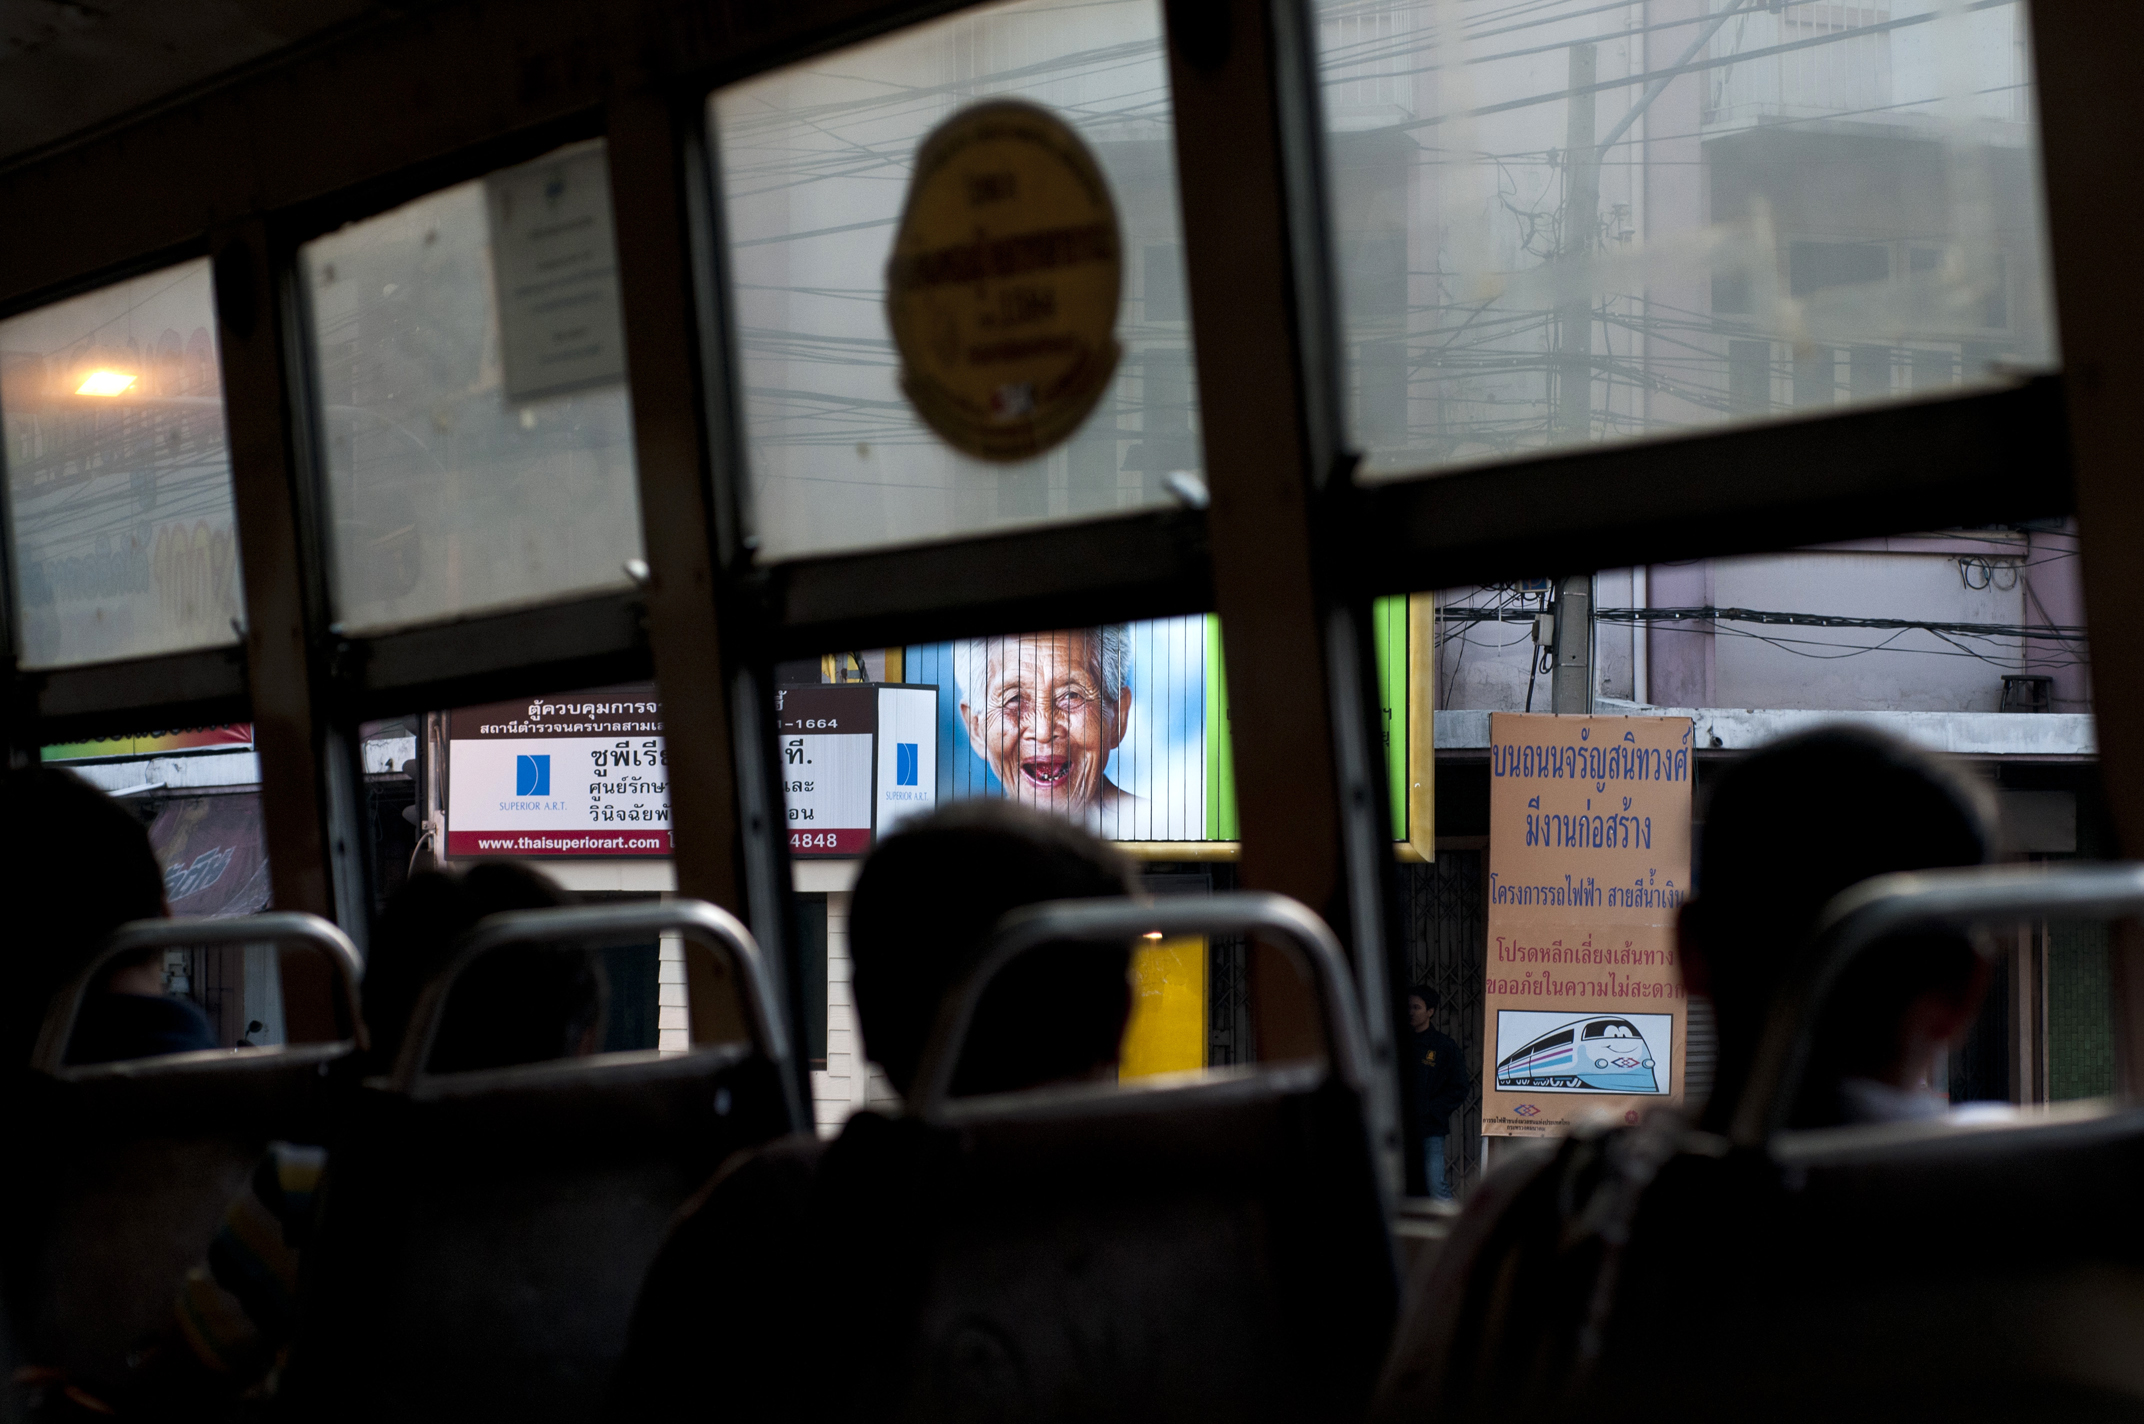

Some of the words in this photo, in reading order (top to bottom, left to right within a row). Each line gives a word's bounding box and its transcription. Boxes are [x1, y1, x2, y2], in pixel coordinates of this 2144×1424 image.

[1492, 727, 1692, 793] บนถนนจรัญสนิทวงศ์
[499, 801, 540, 811] SUPERIOR
[544, 801, 568, 811] A.R.T.
[886, 790, 912, 800] SUPERIOR
[1526, 795, 1651, 849] มีงานก่อสร้าง
[478, 836, 660, 851] www.thaisuperiorart.com
[1490, 872, 1602, 908] โครงการรถไฟฟ้า
[1496, 934, 1674, 966] โปรดหลีกเลี่ยงเส้นทาง
[1486, 971, 1685, 998] ขออภัยในความไม่สะดวก
